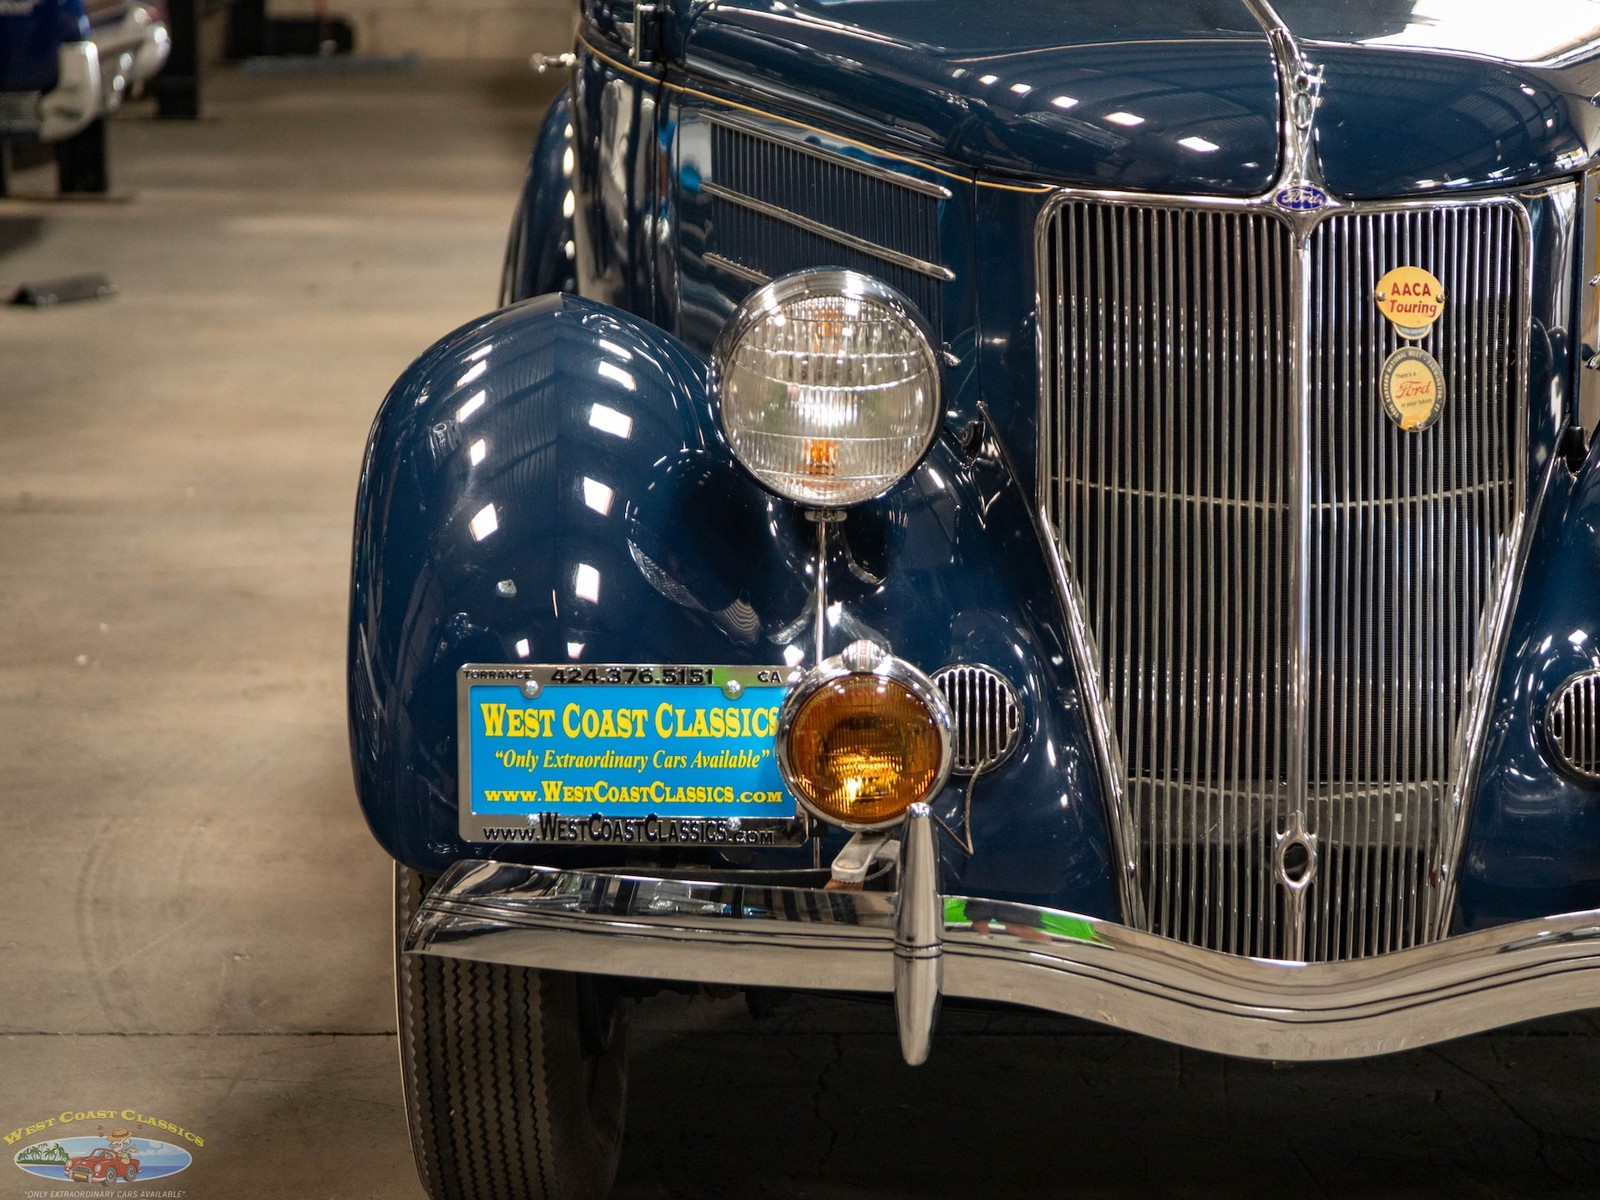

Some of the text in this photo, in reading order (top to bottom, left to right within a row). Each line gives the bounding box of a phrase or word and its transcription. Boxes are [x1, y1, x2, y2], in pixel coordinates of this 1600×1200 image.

[1391, 282, 1431, 296] AACA
[1390, 300, 1437, 317] Touring
[1396, 380, 1432, 399] Ford
[463, 667, 783, 685] TORRANCE 424.376.5151 CA
[480, 703, 556, 739] WEST
[562, 702, 649, 739] COAST
[495, 749, 771, 774] “Only Extraordinary Cars Available”
